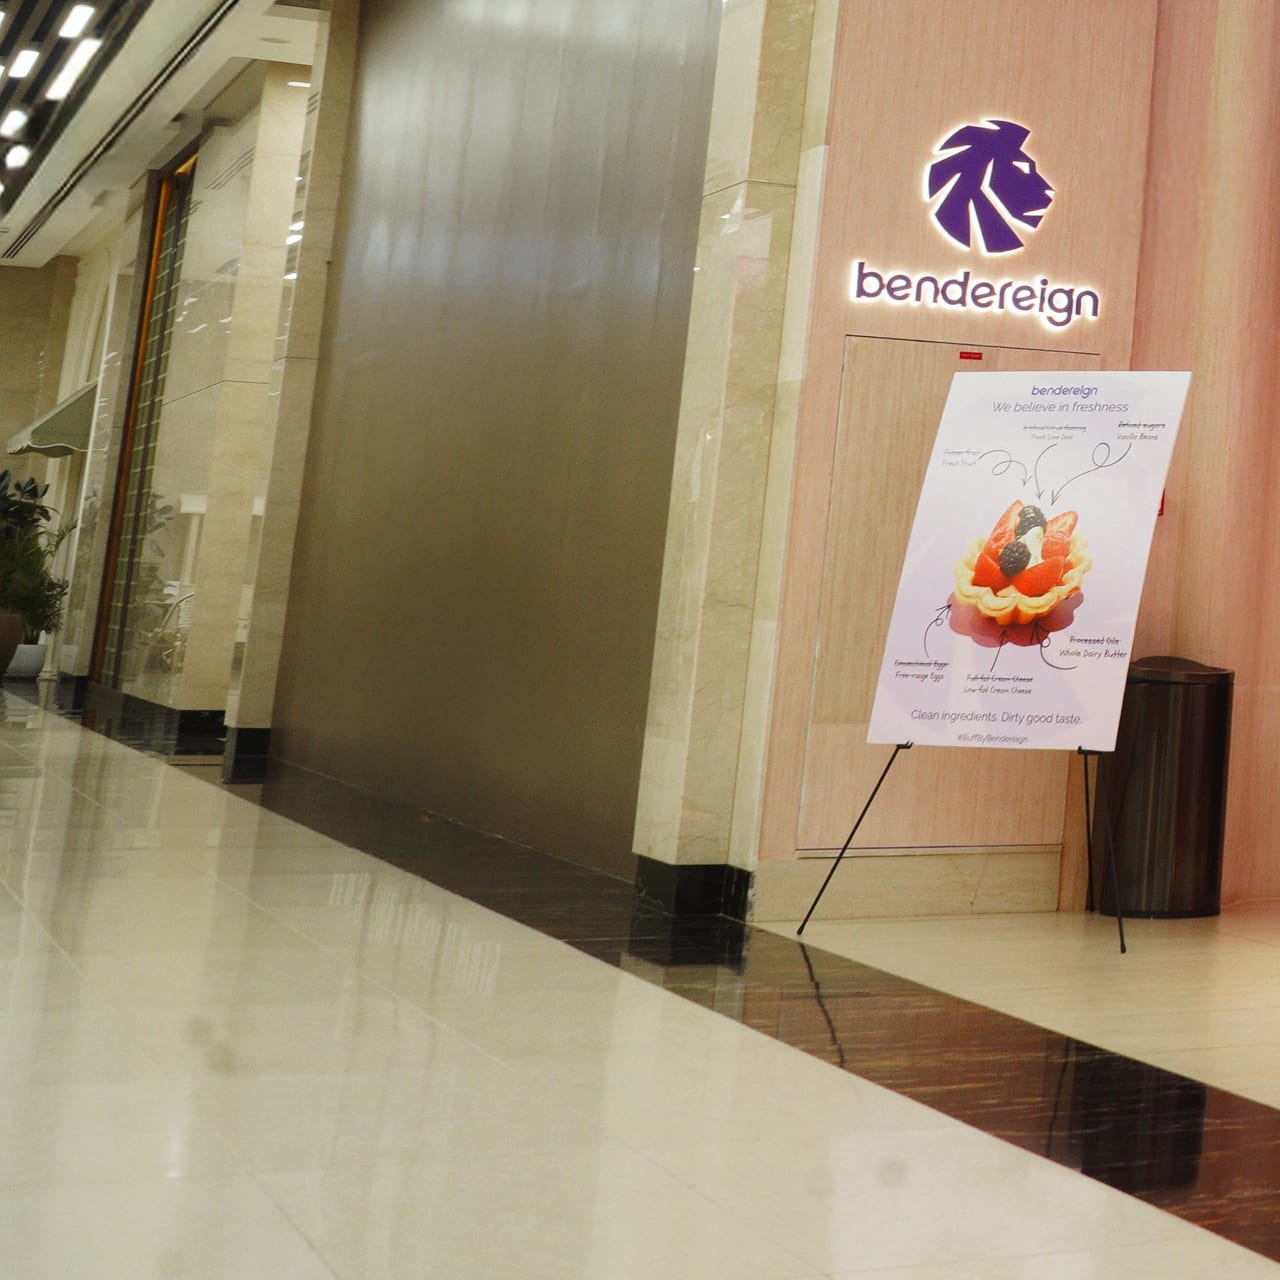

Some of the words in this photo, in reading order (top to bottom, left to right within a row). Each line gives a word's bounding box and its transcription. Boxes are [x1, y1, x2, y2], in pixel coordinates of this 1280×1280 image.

[855, 261, 1100, 328] bendereign
[1031, 384, 1098, 399] bendereign
[993, 401, 1012, 413] We
[1014, 401, 1057, 413] believe
[1059, 401, 1070, 413] in
[1071, 401, 1130, 413] freshness
[1060, 648, 1081, 657] Whole
[1104, 650, 1128, 659] Butter
[911, 709, 940, 720] Clean
[1001, 711, 1025, 725] Dirty
[1026, 713, 1054, 726] good
[1055, 714, 1082, 725] taste.
